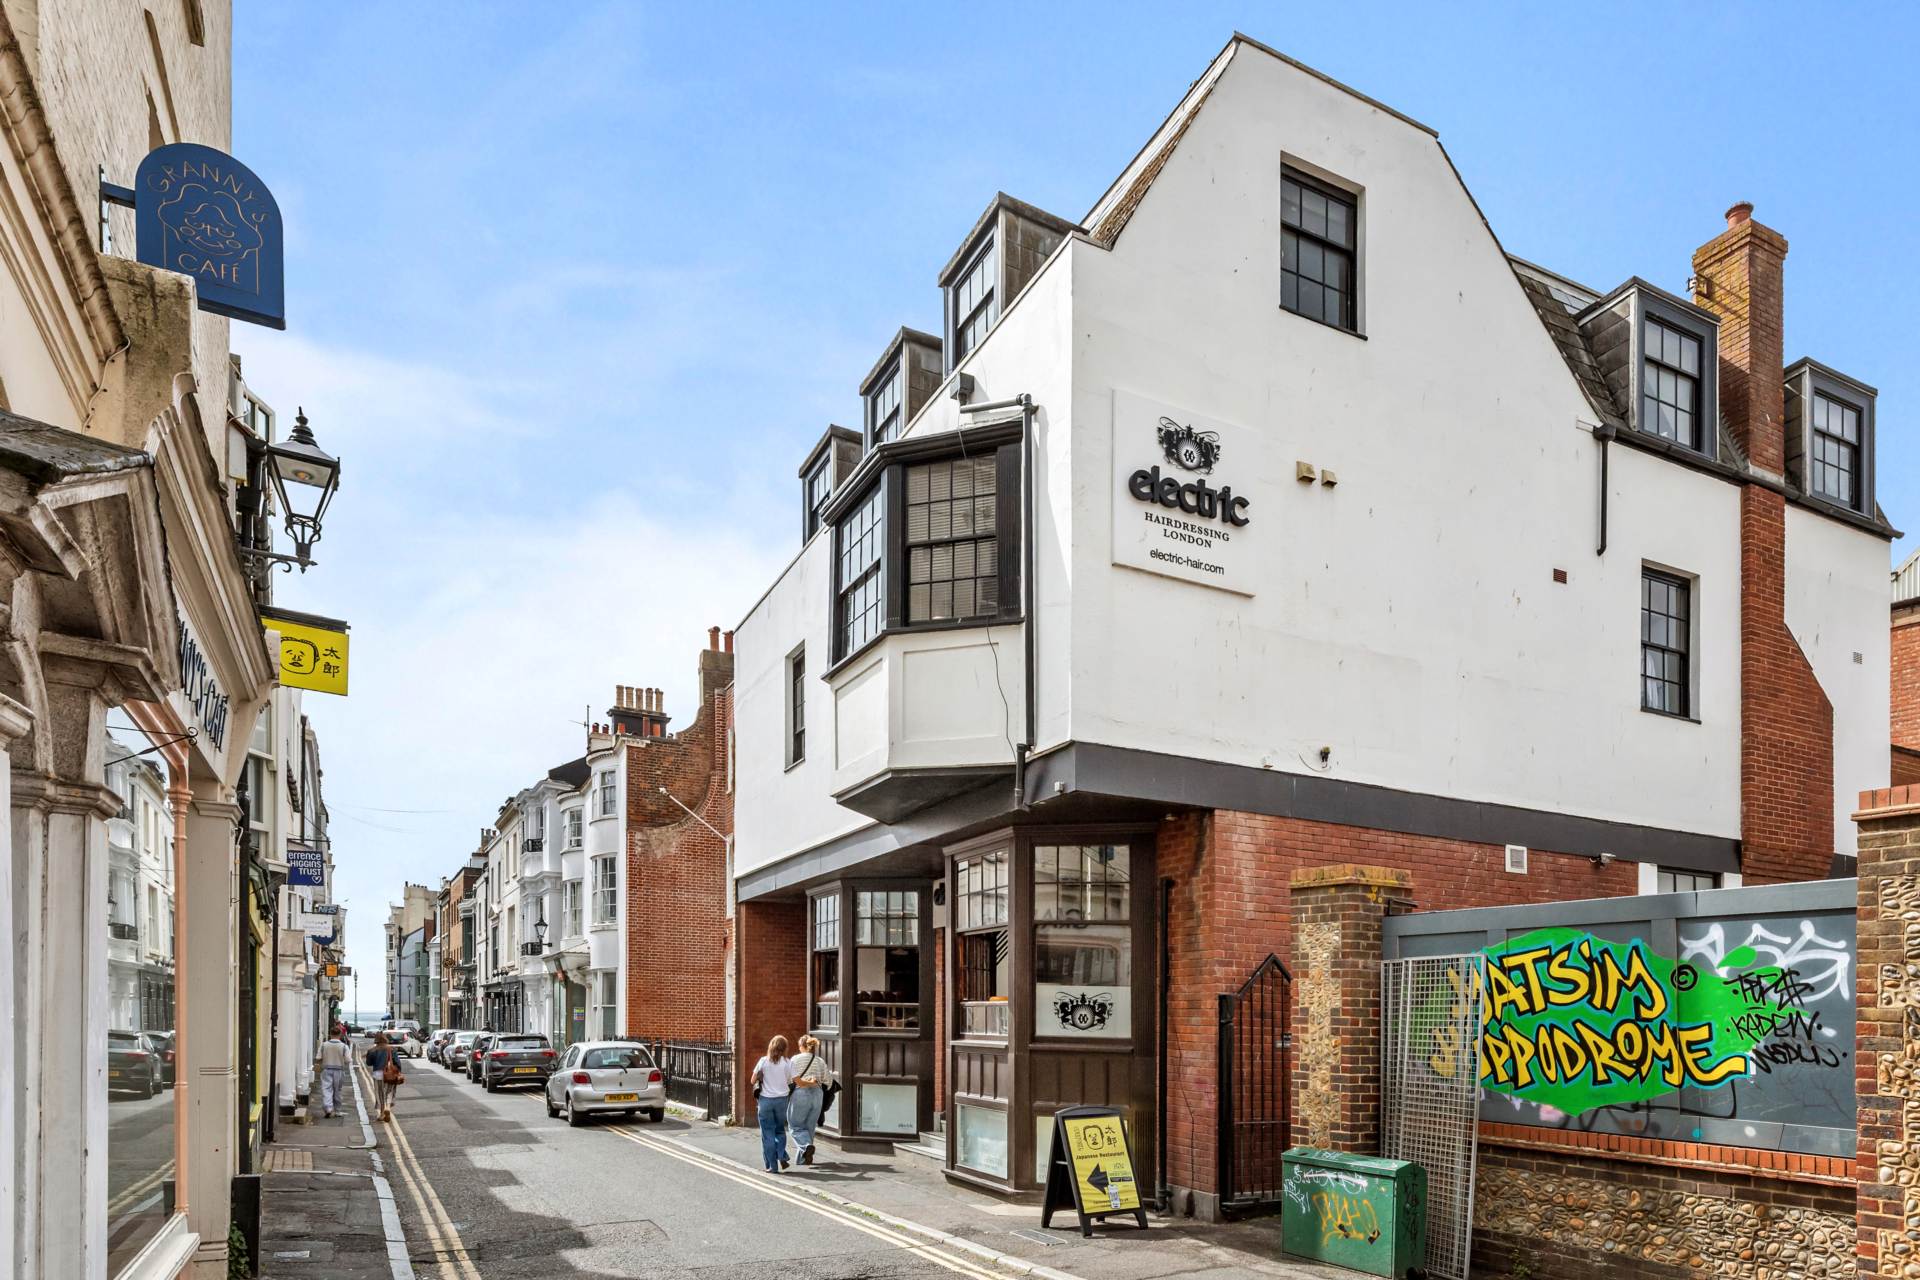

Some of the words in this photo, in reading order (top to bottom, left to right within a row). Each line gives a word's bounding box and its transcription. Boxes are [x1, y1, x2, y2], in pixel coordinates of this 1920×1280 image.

[178, 252, 241, 284] CAFÉ
[1128, 464, 1250, 528] electric
[1144, 511, 1231, 542] HAIRDRESSING
[1163, 528, 1213, 549] LONDON
[1149, 548, 1225, 575] electric-hair.com
[319, 905, 338, 914] NHS
